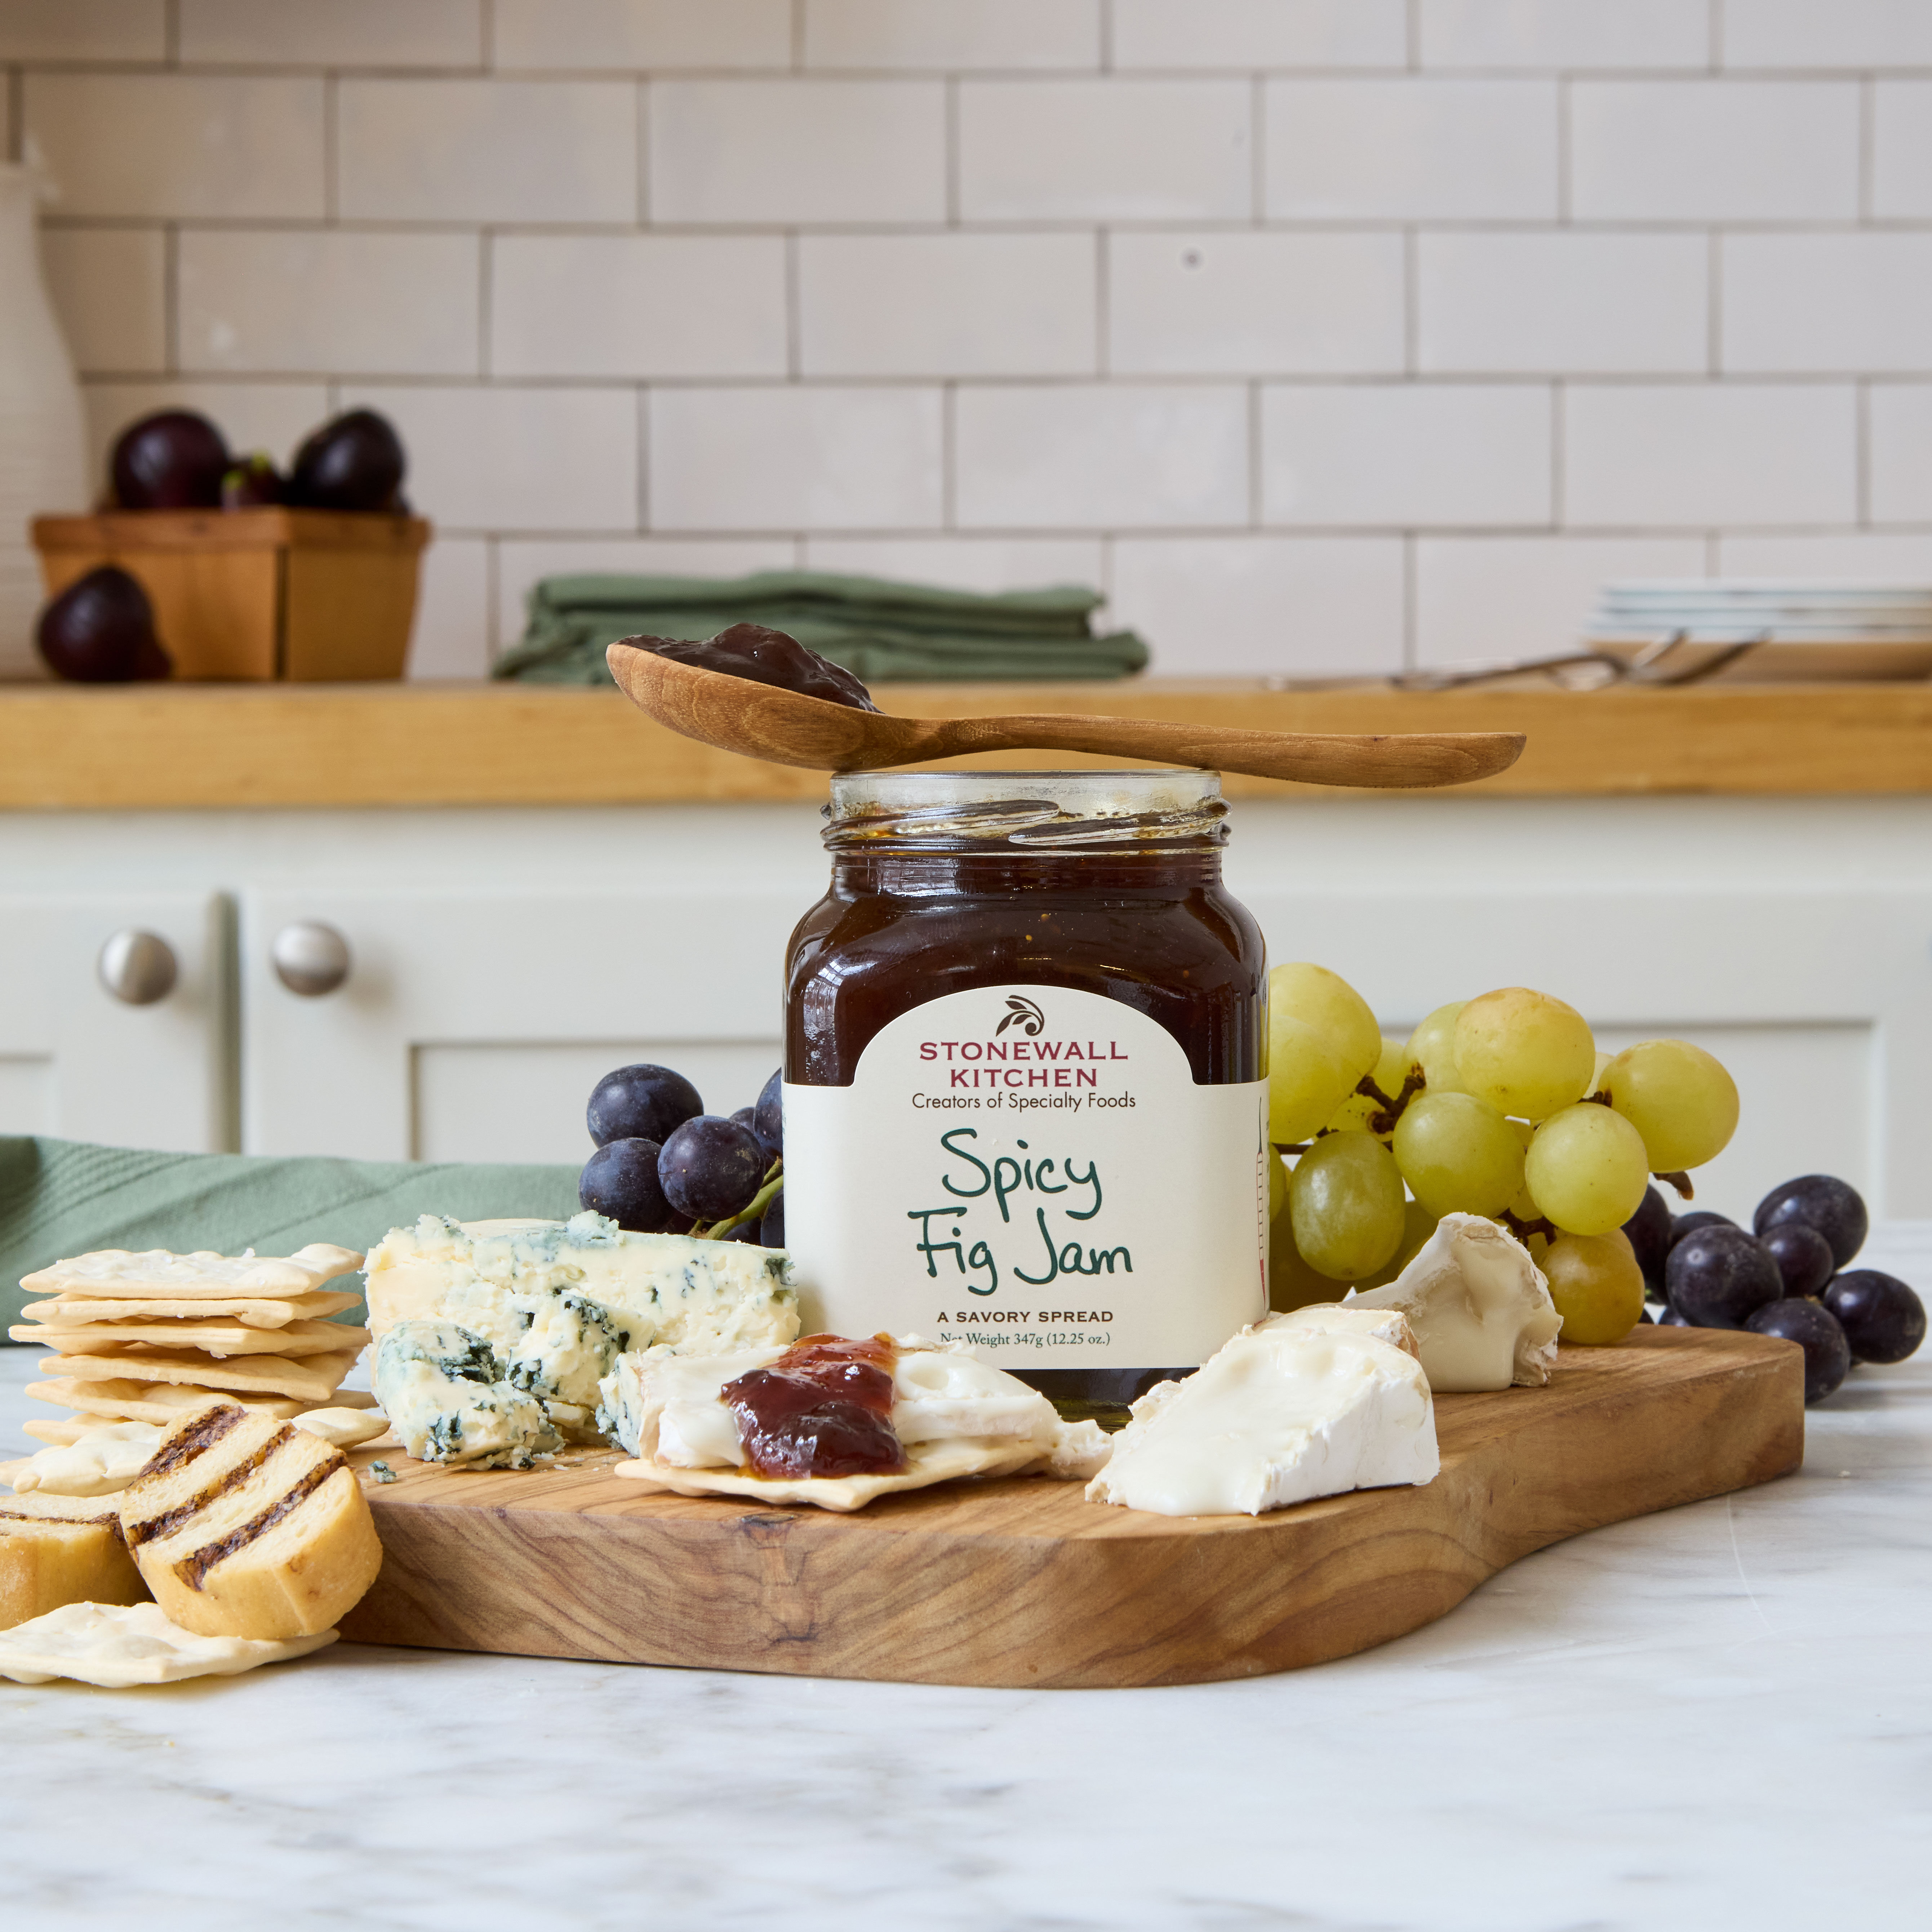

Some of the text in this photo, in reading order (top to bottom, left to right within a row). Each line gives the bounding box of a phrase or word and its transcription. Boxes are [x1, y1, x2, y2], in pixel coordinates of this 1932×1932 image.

[920, 1041, 1128, 1061] STONEWALL
[950, 1068, 1097, 1088] KITCHEN
[912, 1091, 1136, 1113] Creators of Specialty Foods
[941, 1128, 1102, 1223] Spicy
[907, 1207, 1133, 1296] Fig Jam
[937, 1311, 1113, 1323] A SAVORY SPREAD
[965, 1333, 1010, 1348] Weight
[1014, 1333, 1043, 1349] 347g
[1047, 1332, 1084, 1346] (12.25
[1088, 1332, 1110, 1346] oz.)
